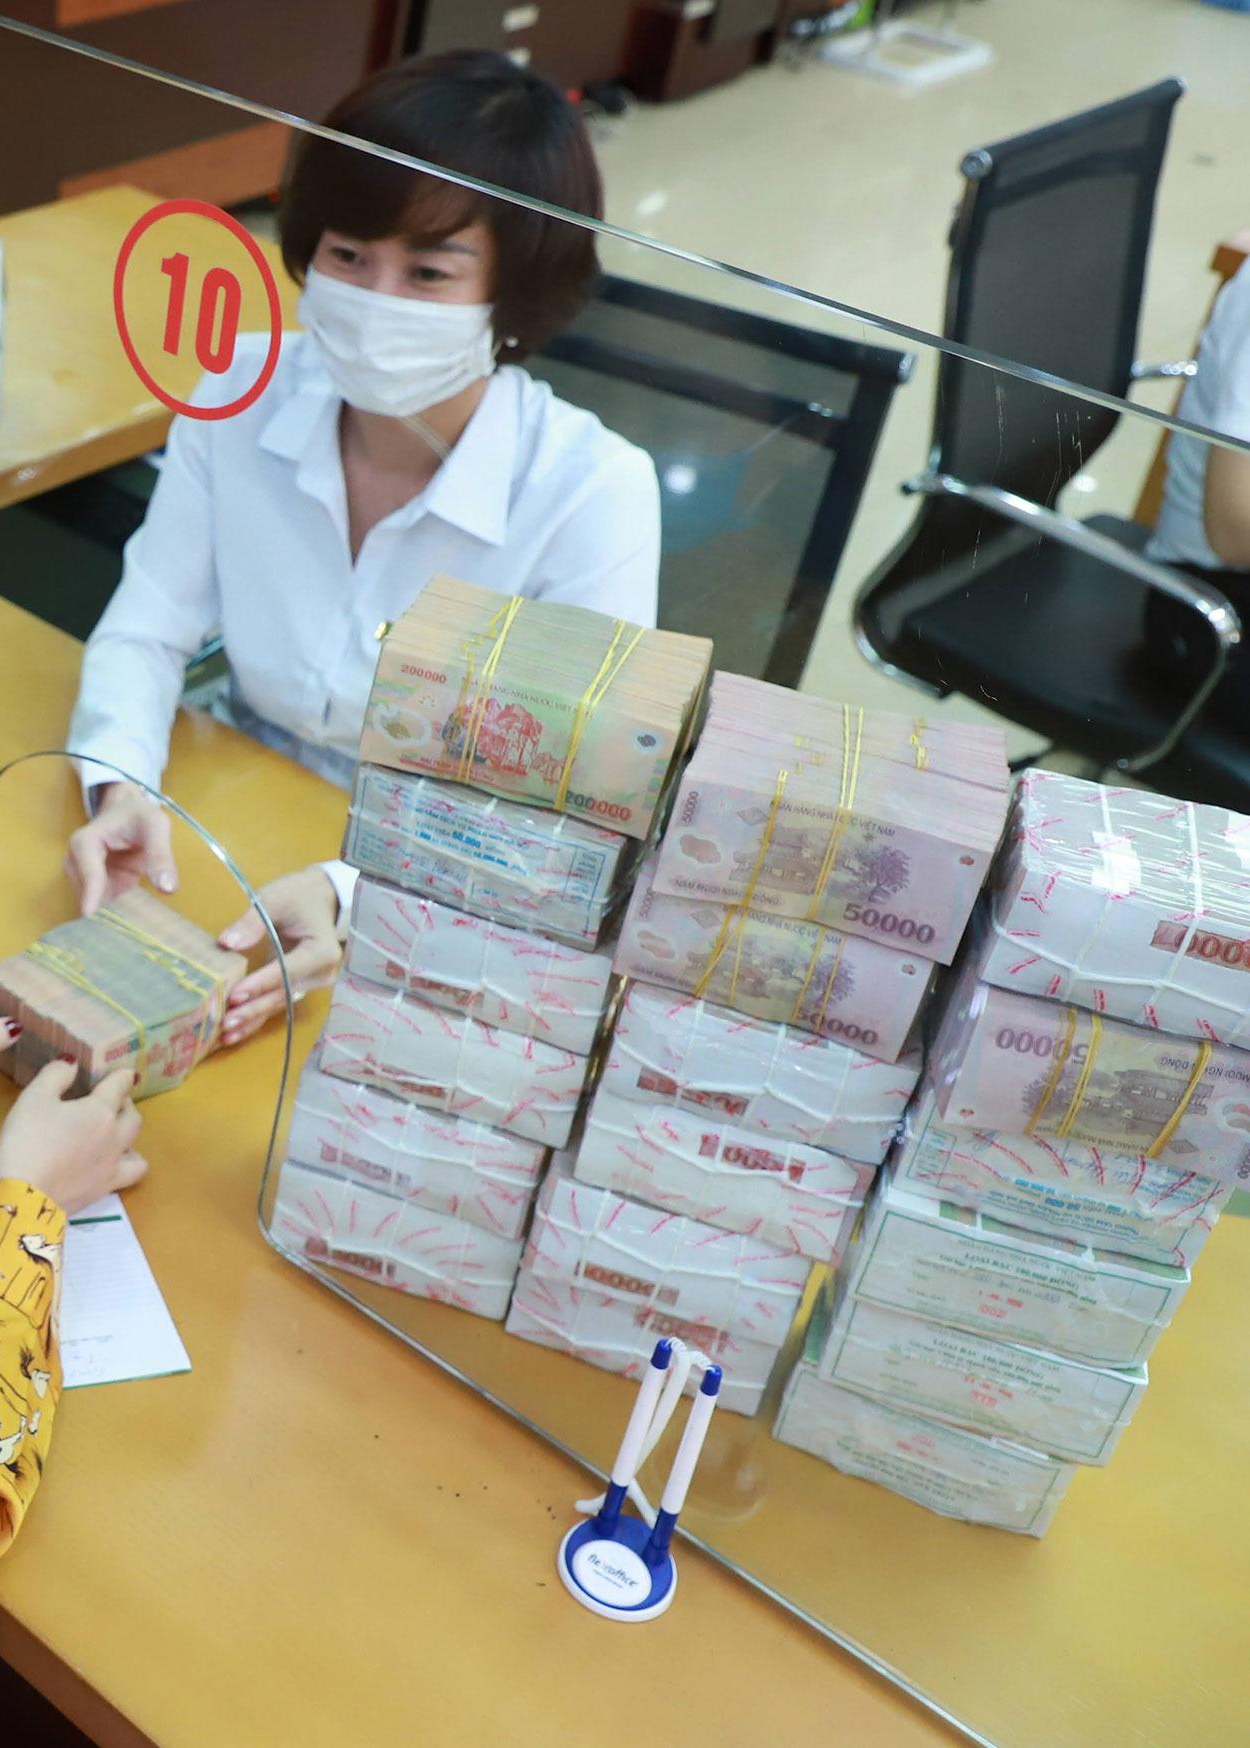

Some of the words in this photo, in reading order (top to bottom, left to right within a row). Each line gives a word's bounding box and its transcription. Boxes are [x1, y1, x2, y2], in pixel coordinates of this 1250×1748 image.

[161, 252, 241, 374] 10
[843, 902, 936, 944] 50000
[995, 1028, 1091, 1065] 50000
